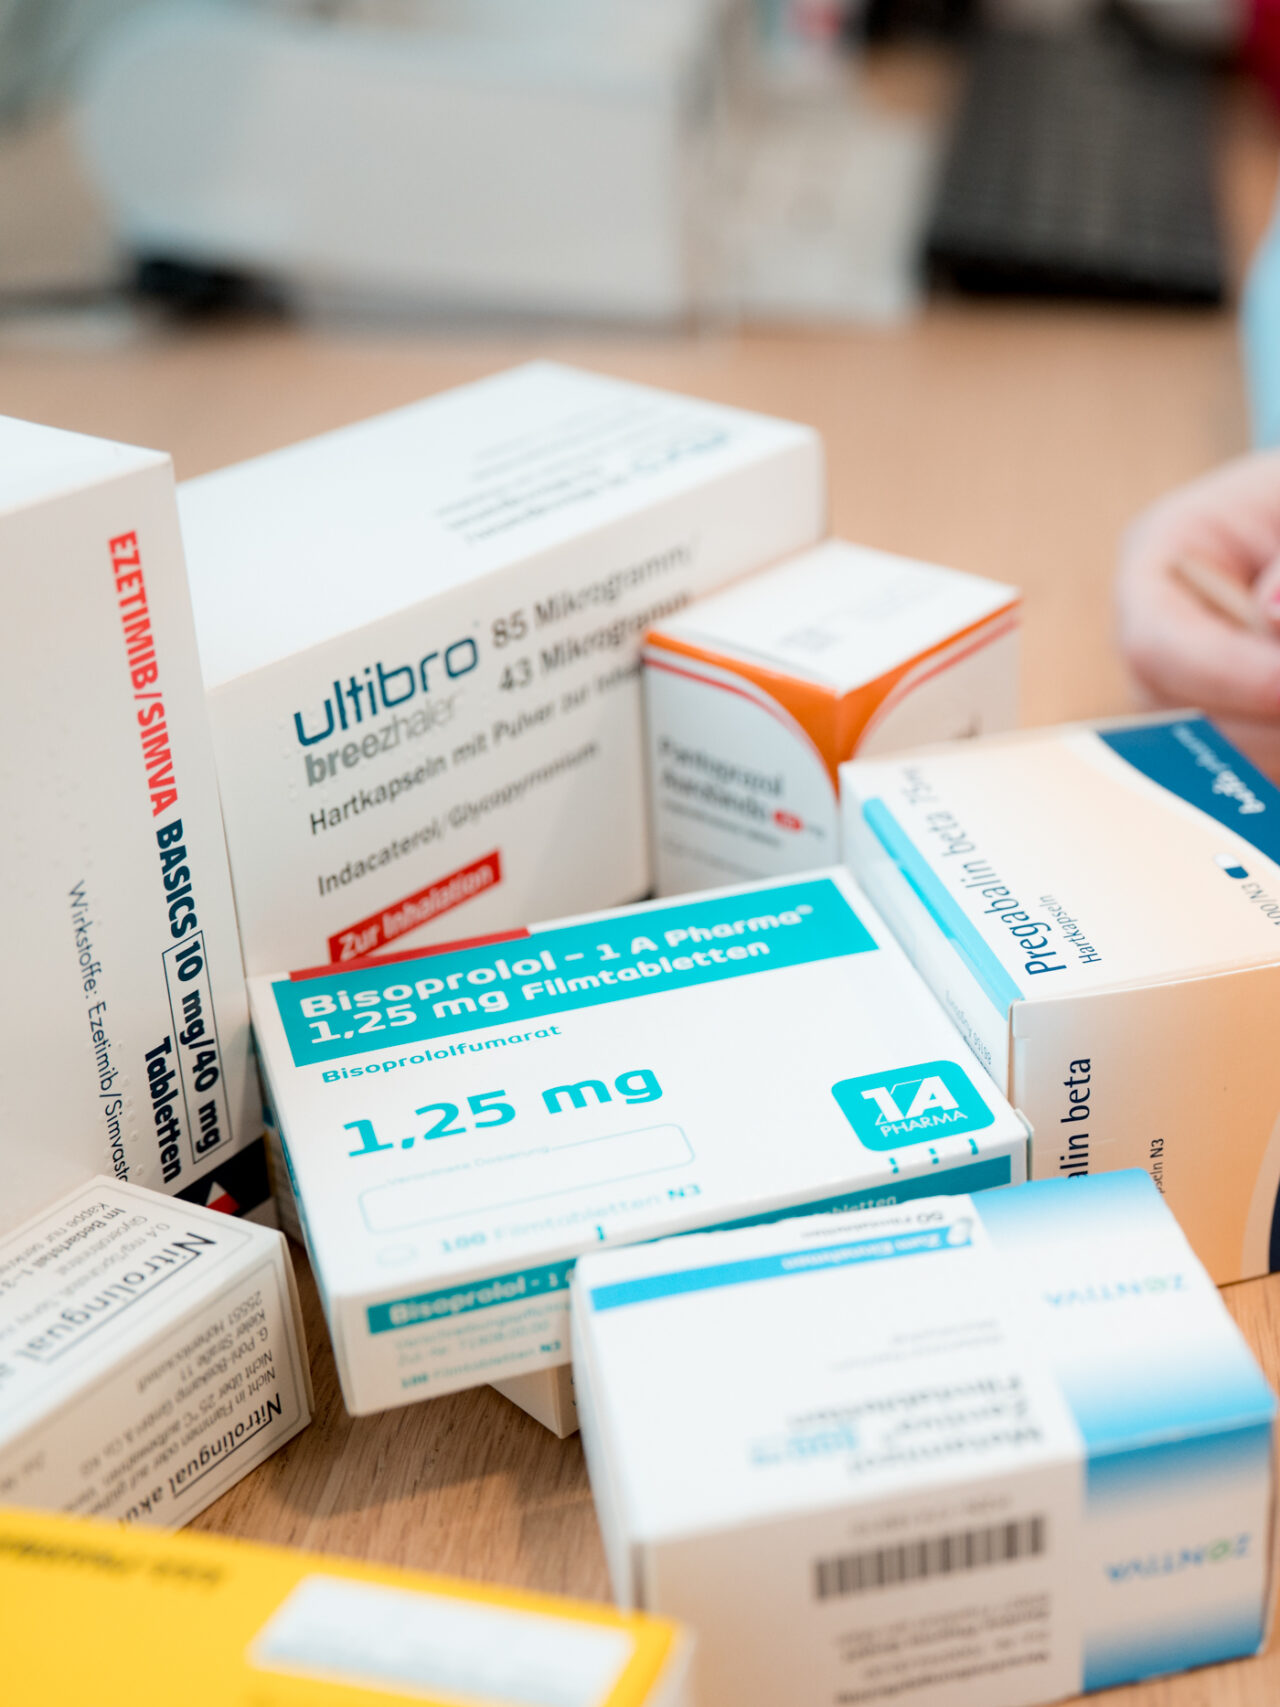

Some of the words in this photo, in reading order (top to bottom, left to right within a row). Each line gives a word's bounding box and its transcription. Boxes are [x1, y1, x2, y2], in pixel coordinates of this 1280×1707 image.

[491, 608, 528, 650] 85
[108, 530, 178, 817] EZETIMIB/SIMVA
[293, 637, 479, 747] ultibro
[499, 660, 533, 694] 43
[304, 695, 459, 787] breezhaler
[309, 753, 448, 836] Hartkapseln
[452, 733, 488, 766] mit
[492, 699, 556, 748] Pulver
[925, 810, 976, 857] beta
[156, 818, 197, 939] BASICS
[337, 925, 380, 962] Zur
[382, 862, 496, 940] Inhalation
[960, 860, 1067, 976] Pregabalin
[69, 880, 102, 998] Wirkstoffe:
[175, 941, 203, 982] 10
[1039, 893, 1102, 965] Hartkapseln
[299, 949, 558, 1021] Bisoprolol
[594, 942, 621, 963] 1
[629, 934, 659, 956] A
[308, 1003, 419, 1045] 1,25
[432, 988, 510, 1022] mg
[520, 941, 770, 1002] Filmtabletten
[179, 988, 219, 1094] mg/40
[321, 1024, 562, 1084] Bisoprololfumarat
[144, 1035, 182, 1184] Tabletten
[196, 1099, 221, 1155] mg
[342, 1089, 517, 1158] 1,25
[541, 1068, 664, 1116] mg
[880, 1109, 969, 1138] PHARMA
[1060, 1058, 1091, 1123] beta
[1149, 1138, 1165, 1159] N3
[441, 1231, 487, 1255] 100
[667, 1183, 703, 1203] N3
[14, 1231, 217, 1362] Nitrolingual
[388, 1275, 527, 1326] Bisoprolol
[235, 1392, 247, 1405] in
[244, 1348, 274, 1375] Nicht
[248, 1365, 277, 1393] Nicht
[168, 1391, 283, 1496] Nitrolingual
